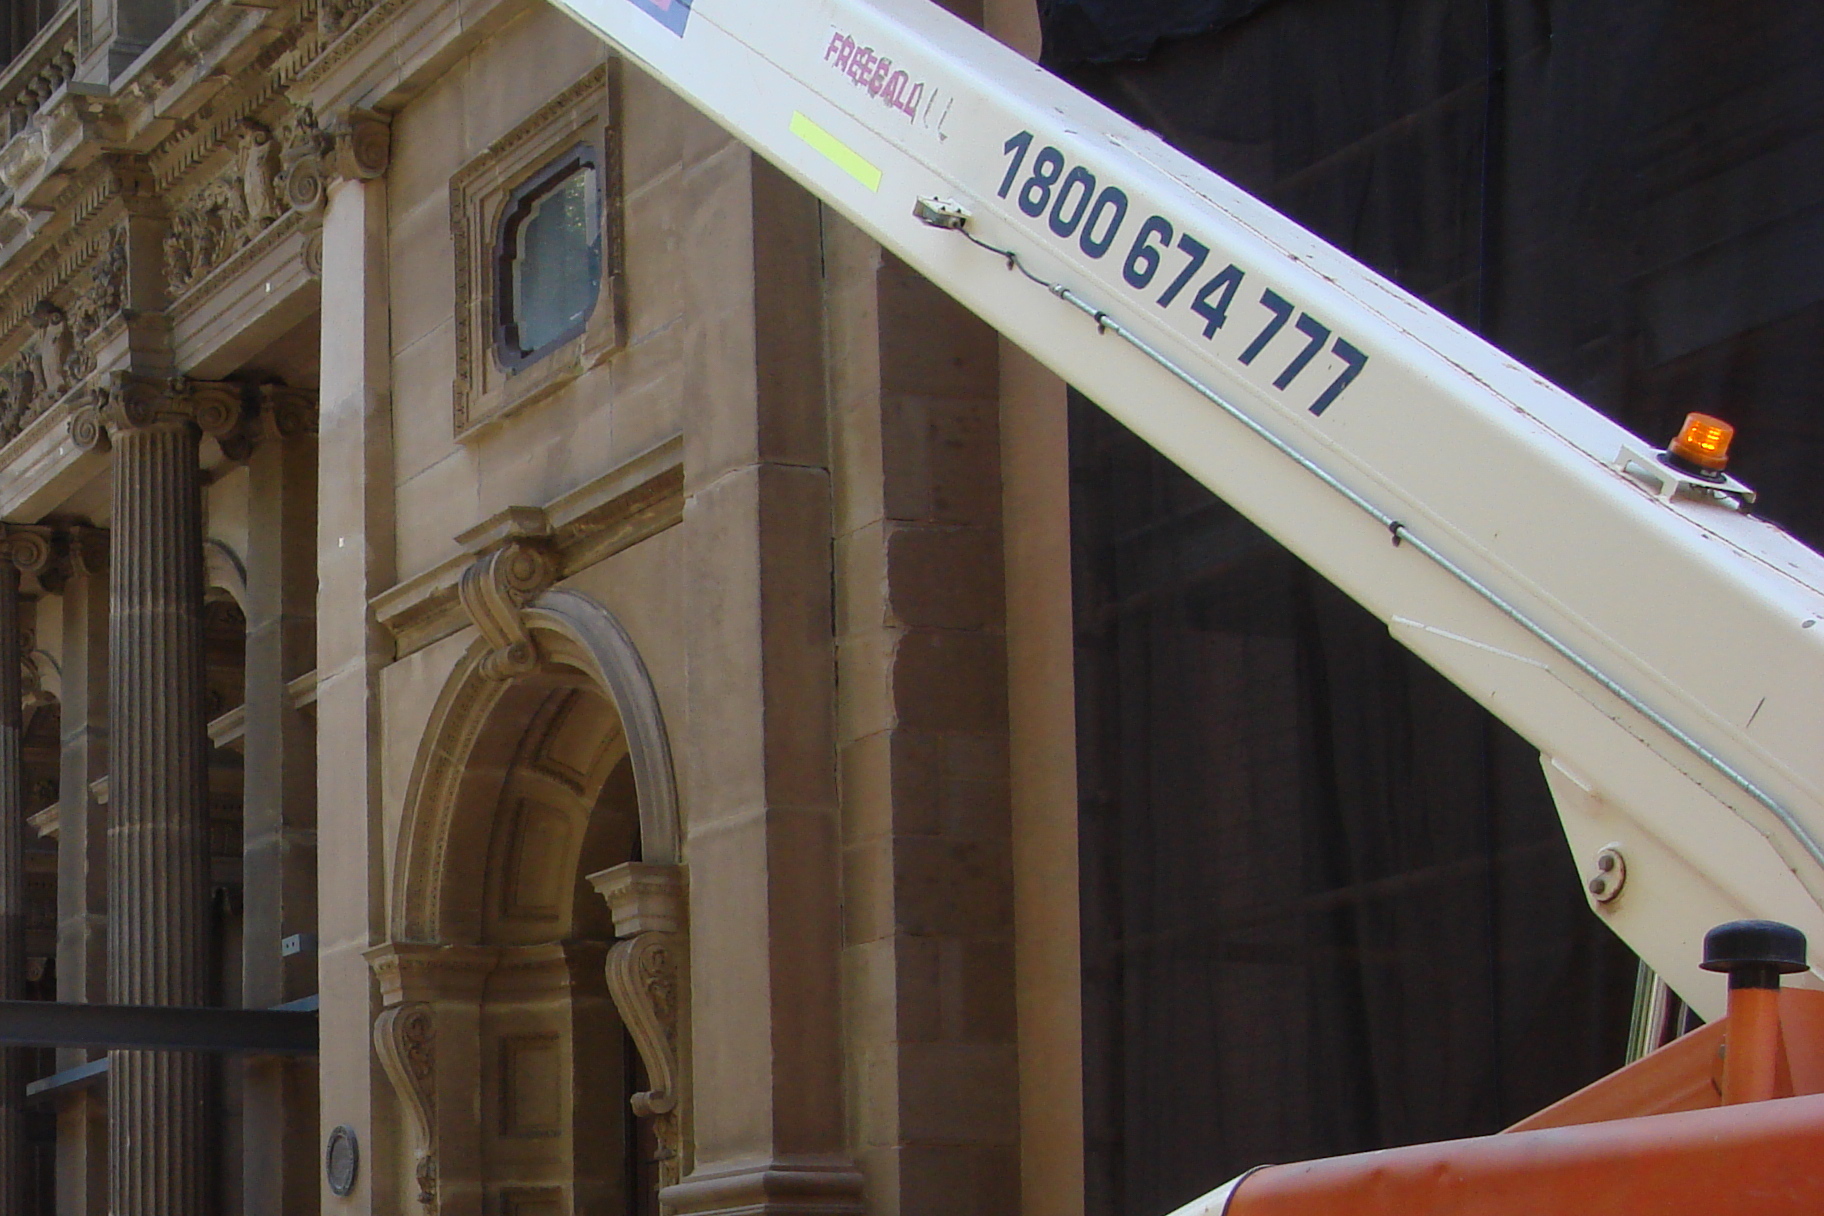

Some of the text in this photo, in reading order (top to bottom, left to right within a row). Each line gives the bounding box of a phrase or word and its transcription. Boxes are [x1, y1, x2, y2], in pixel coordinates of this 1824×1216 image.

[997, 130, 1369, 418] 1800 674 777
